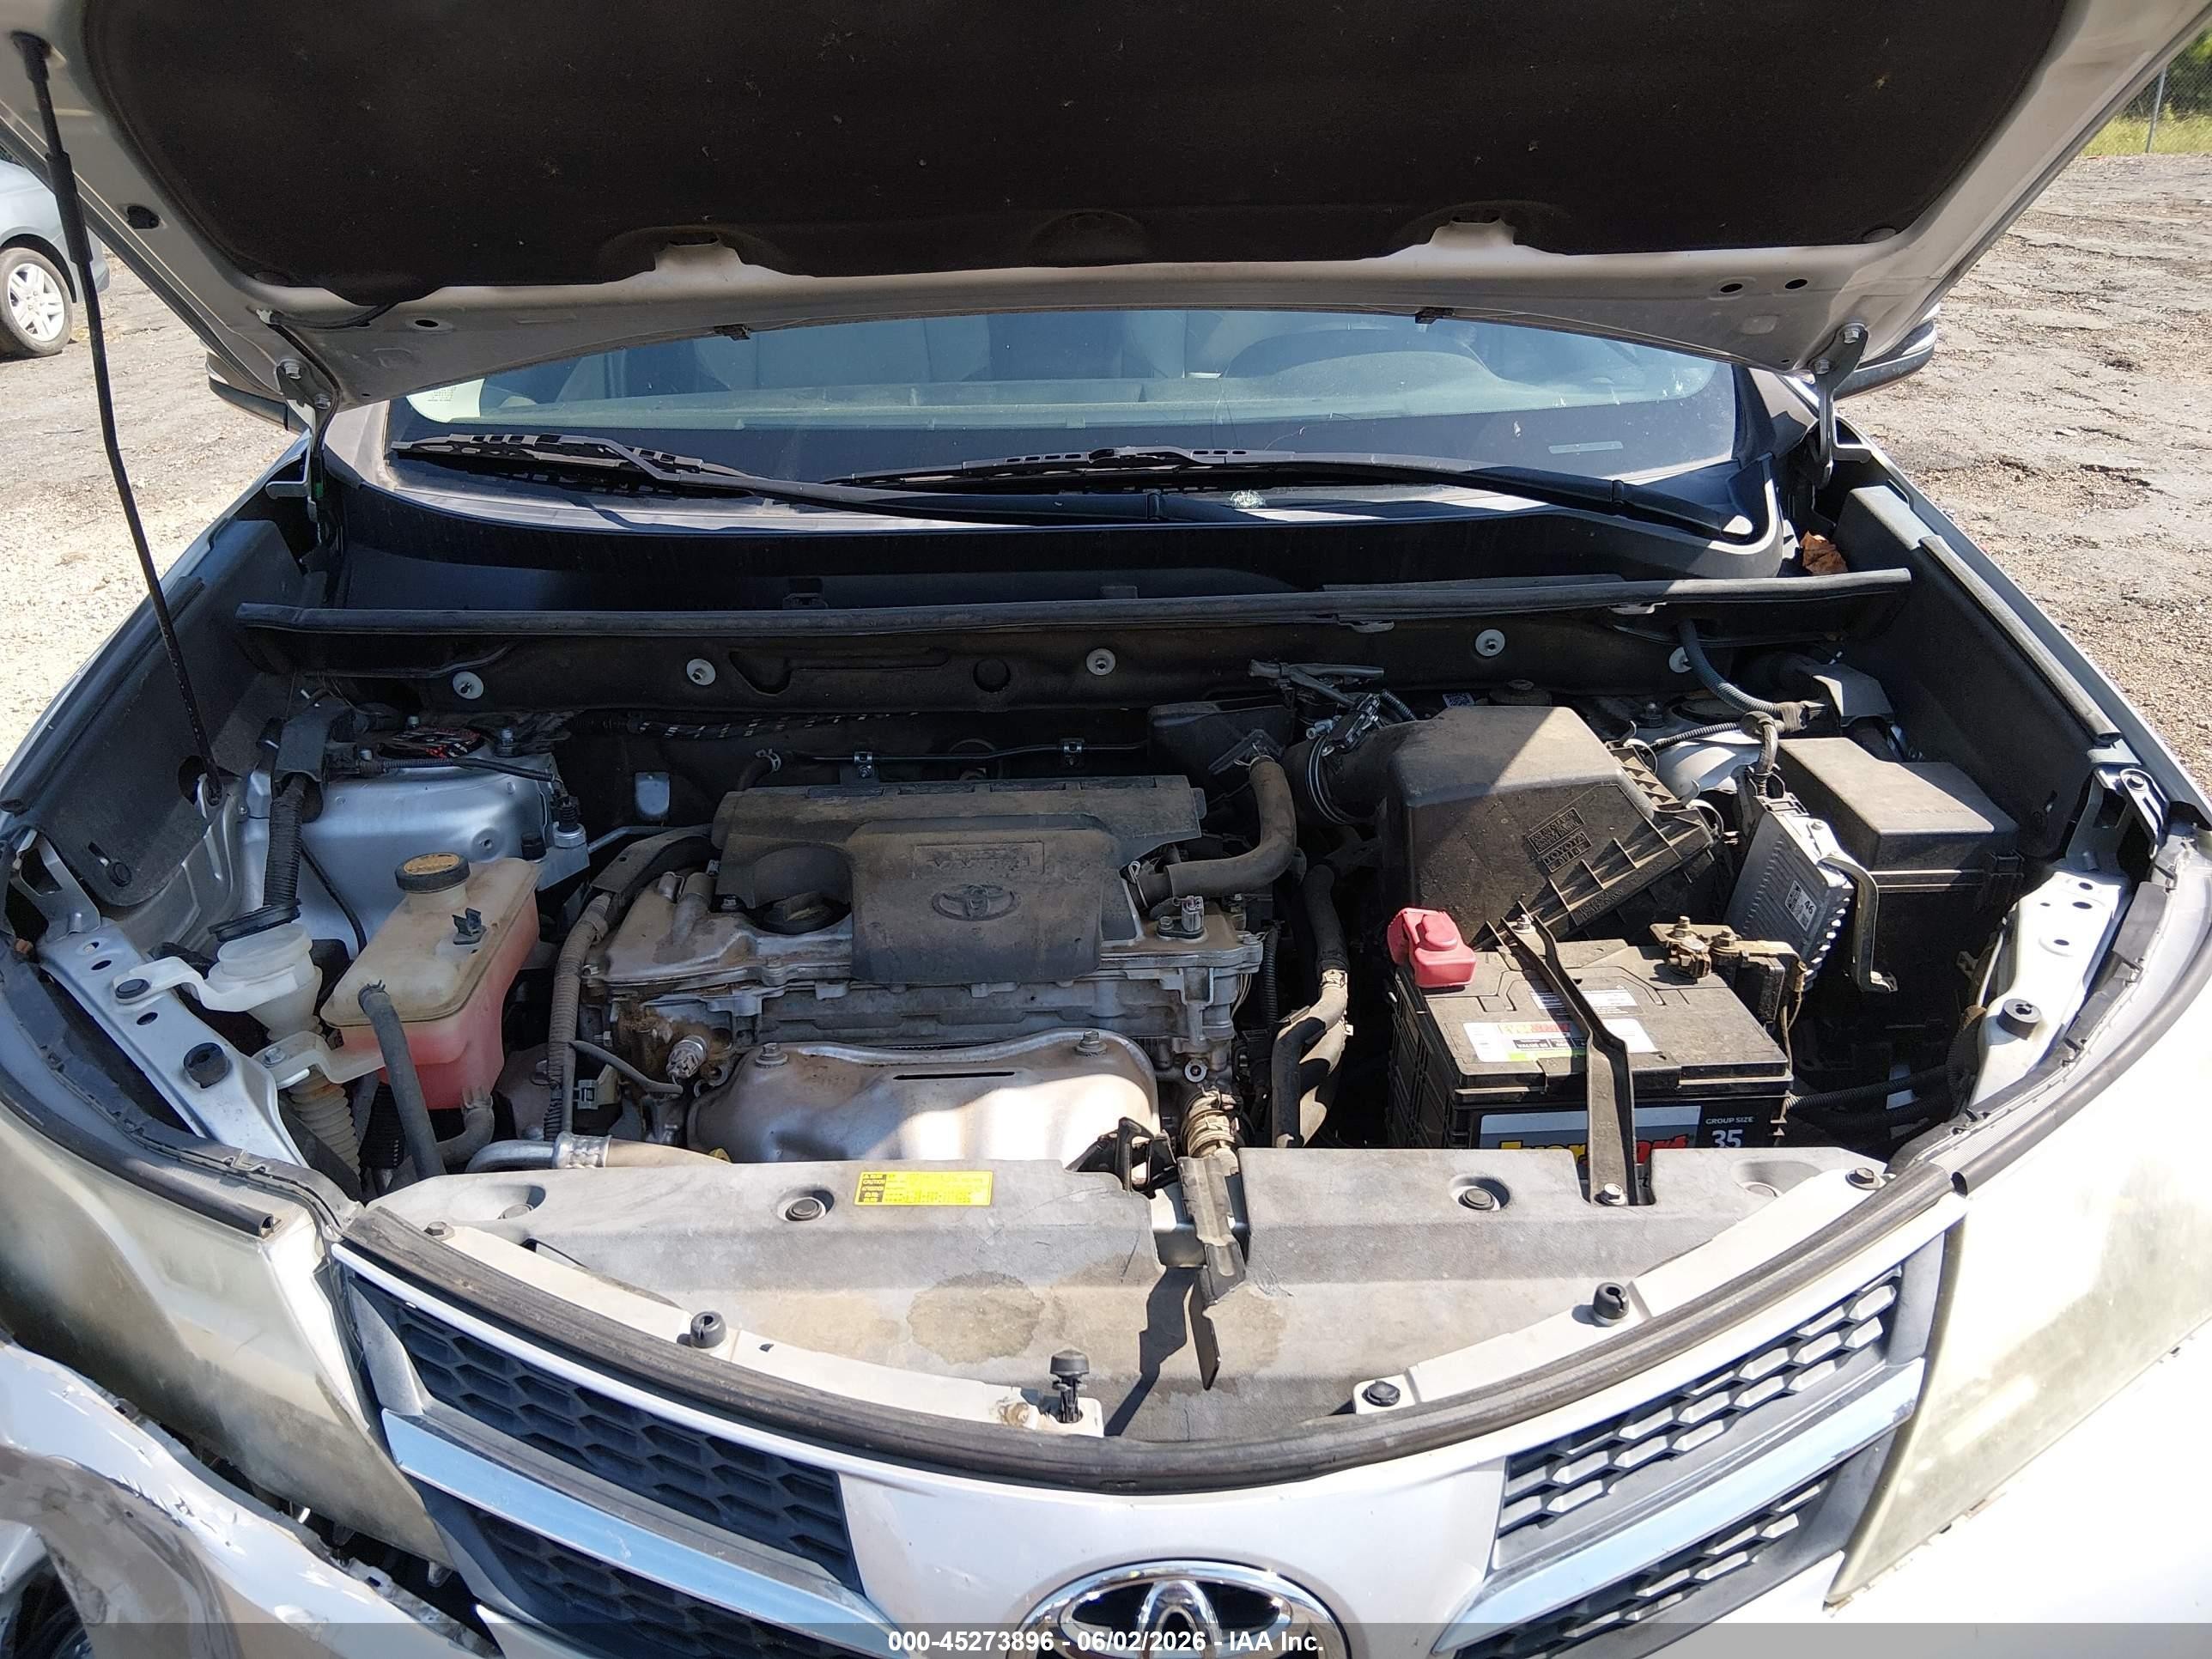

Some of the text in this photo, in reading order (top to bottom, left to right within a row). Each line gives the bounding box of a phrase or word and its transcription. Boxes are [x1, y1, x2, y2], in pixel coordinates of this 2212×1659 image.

[1541, 832, 1586, 864] TOYOTA
[1804, 901, 1814, 914] 46
[1711, 1129, 1743, 1148] 35
